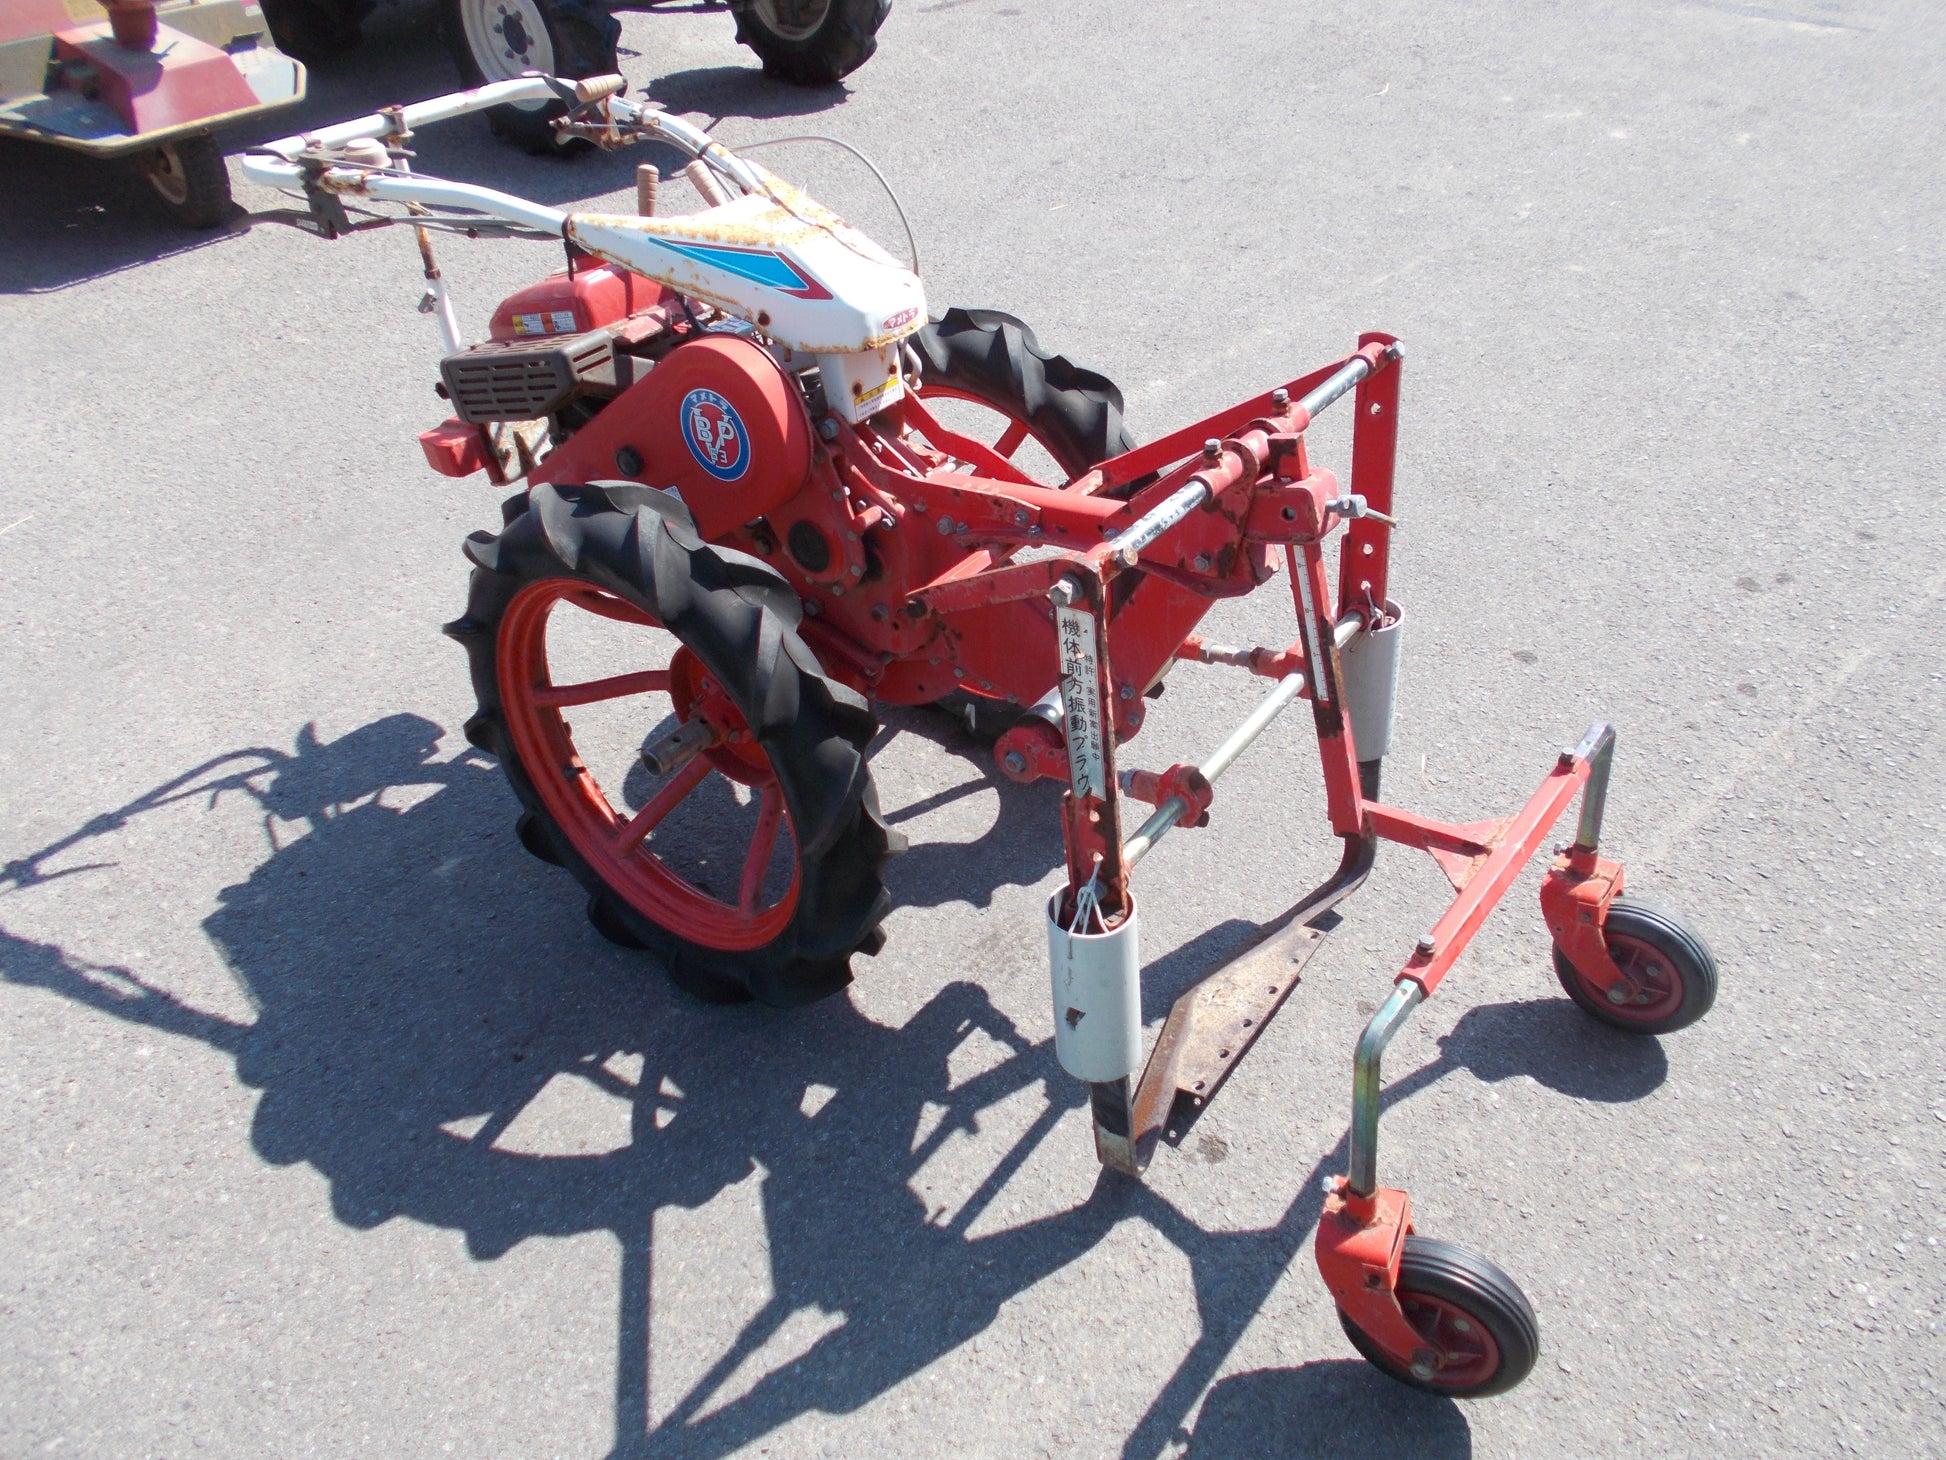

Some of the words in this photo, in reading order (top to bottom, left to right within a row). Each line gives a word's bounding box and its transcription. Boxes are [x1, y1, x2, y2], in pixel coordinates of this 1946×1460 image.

[889, 308, 916, 328] マメトラ
[690, 391, 729, 411] マメトラ
[1061, 617, 1089, 790] 機体前方振動プラウ
